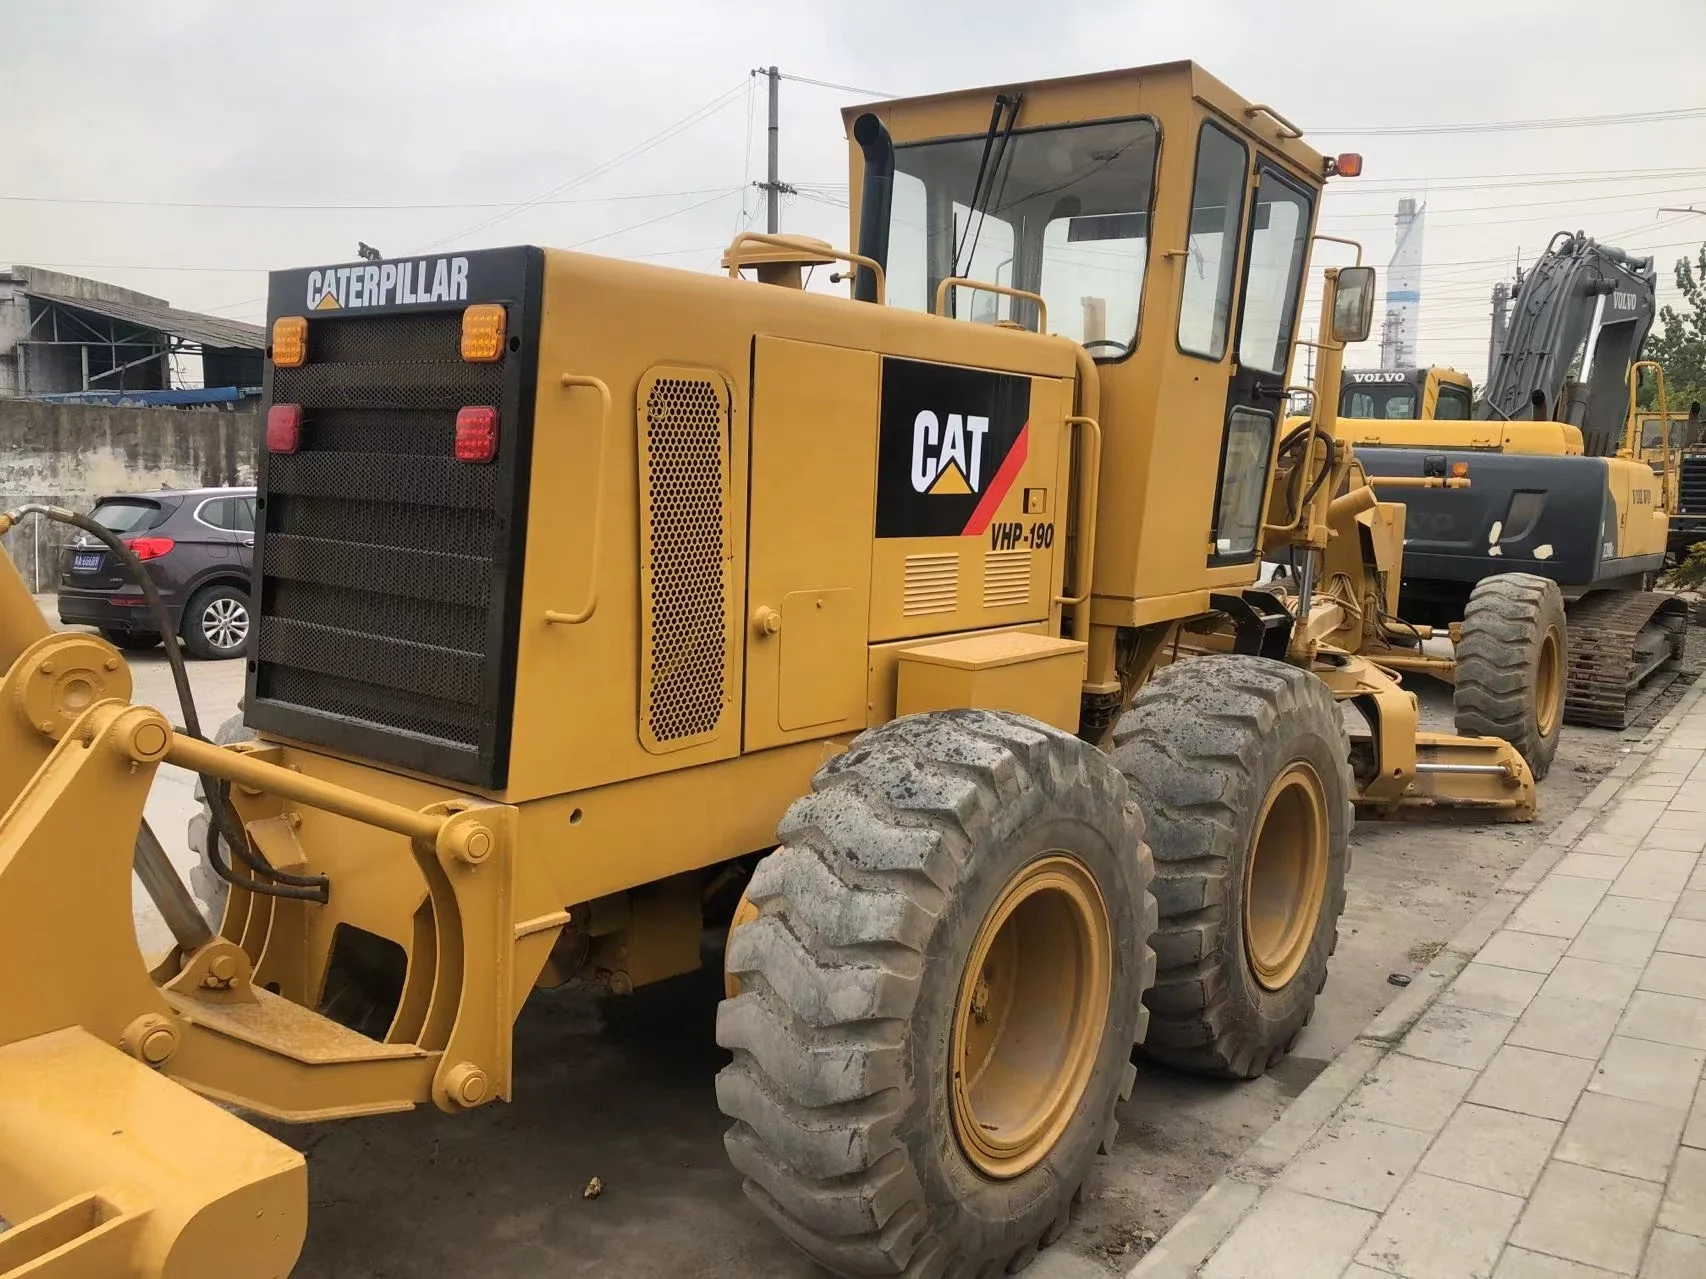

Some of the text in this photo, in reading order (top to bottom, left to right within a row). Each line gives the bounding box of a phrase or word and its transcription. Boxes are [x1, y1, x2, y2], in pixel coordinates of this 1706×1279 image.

[306, 257, 469, 311] CATERPILLAR
[1613, 291, 1637, 310] VOLVO
[1352, 372, 1405, 383] VOLVO
[911, 409, 989, 493] CAT
